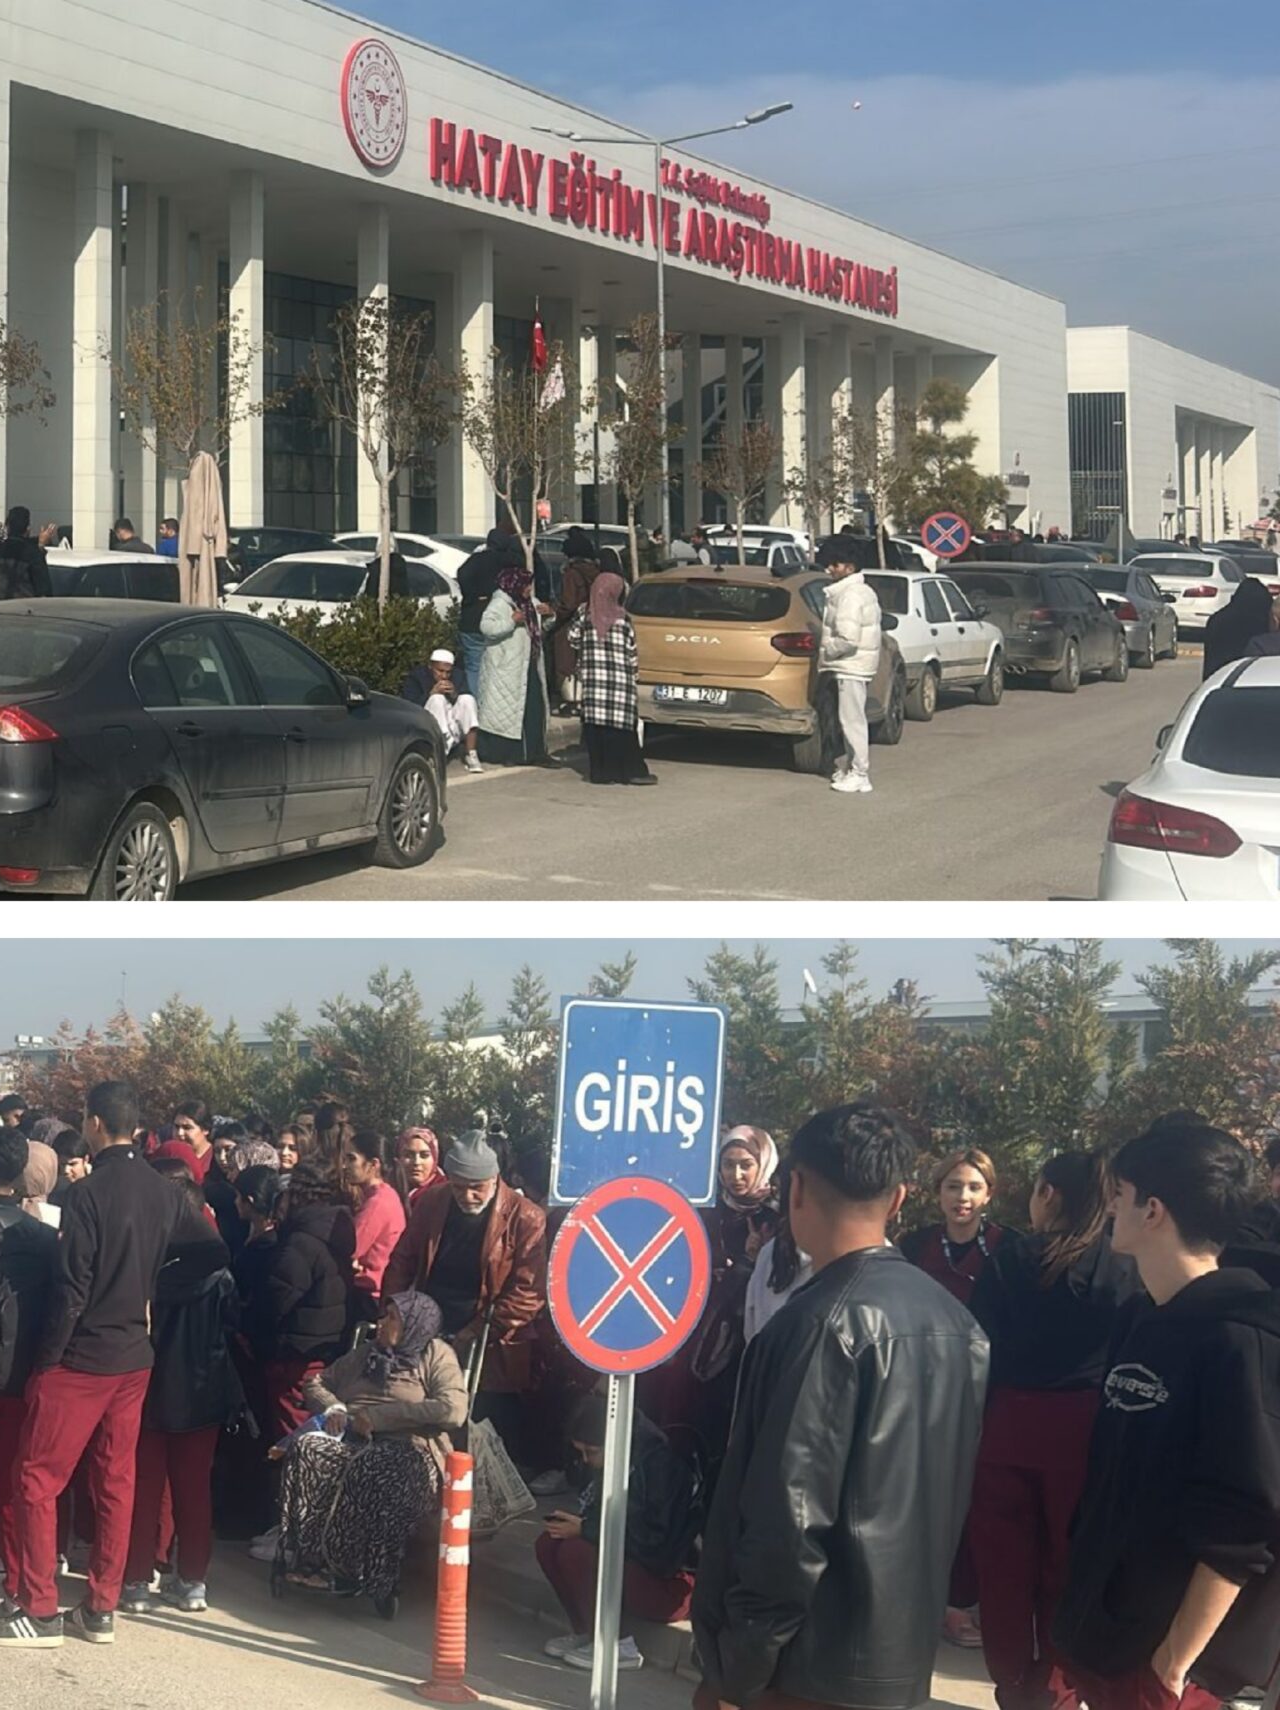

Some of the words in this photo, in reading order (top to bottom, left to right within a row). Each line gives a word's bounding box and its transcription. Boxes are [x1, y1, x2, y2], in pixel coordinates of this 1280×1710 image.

[430, 117, 544, 210] HATAY
[547, 151, 644, 242] EĞİTİM
[649, 194, 681, 252] VE
[683, 209, 805, 291] ARAŞTIRMA
[805, 247, 898, 318] HASTANESİ
[665, 634, 721, 645] DACIA
[575, 1059, 705, 1149] GİRİŞ
